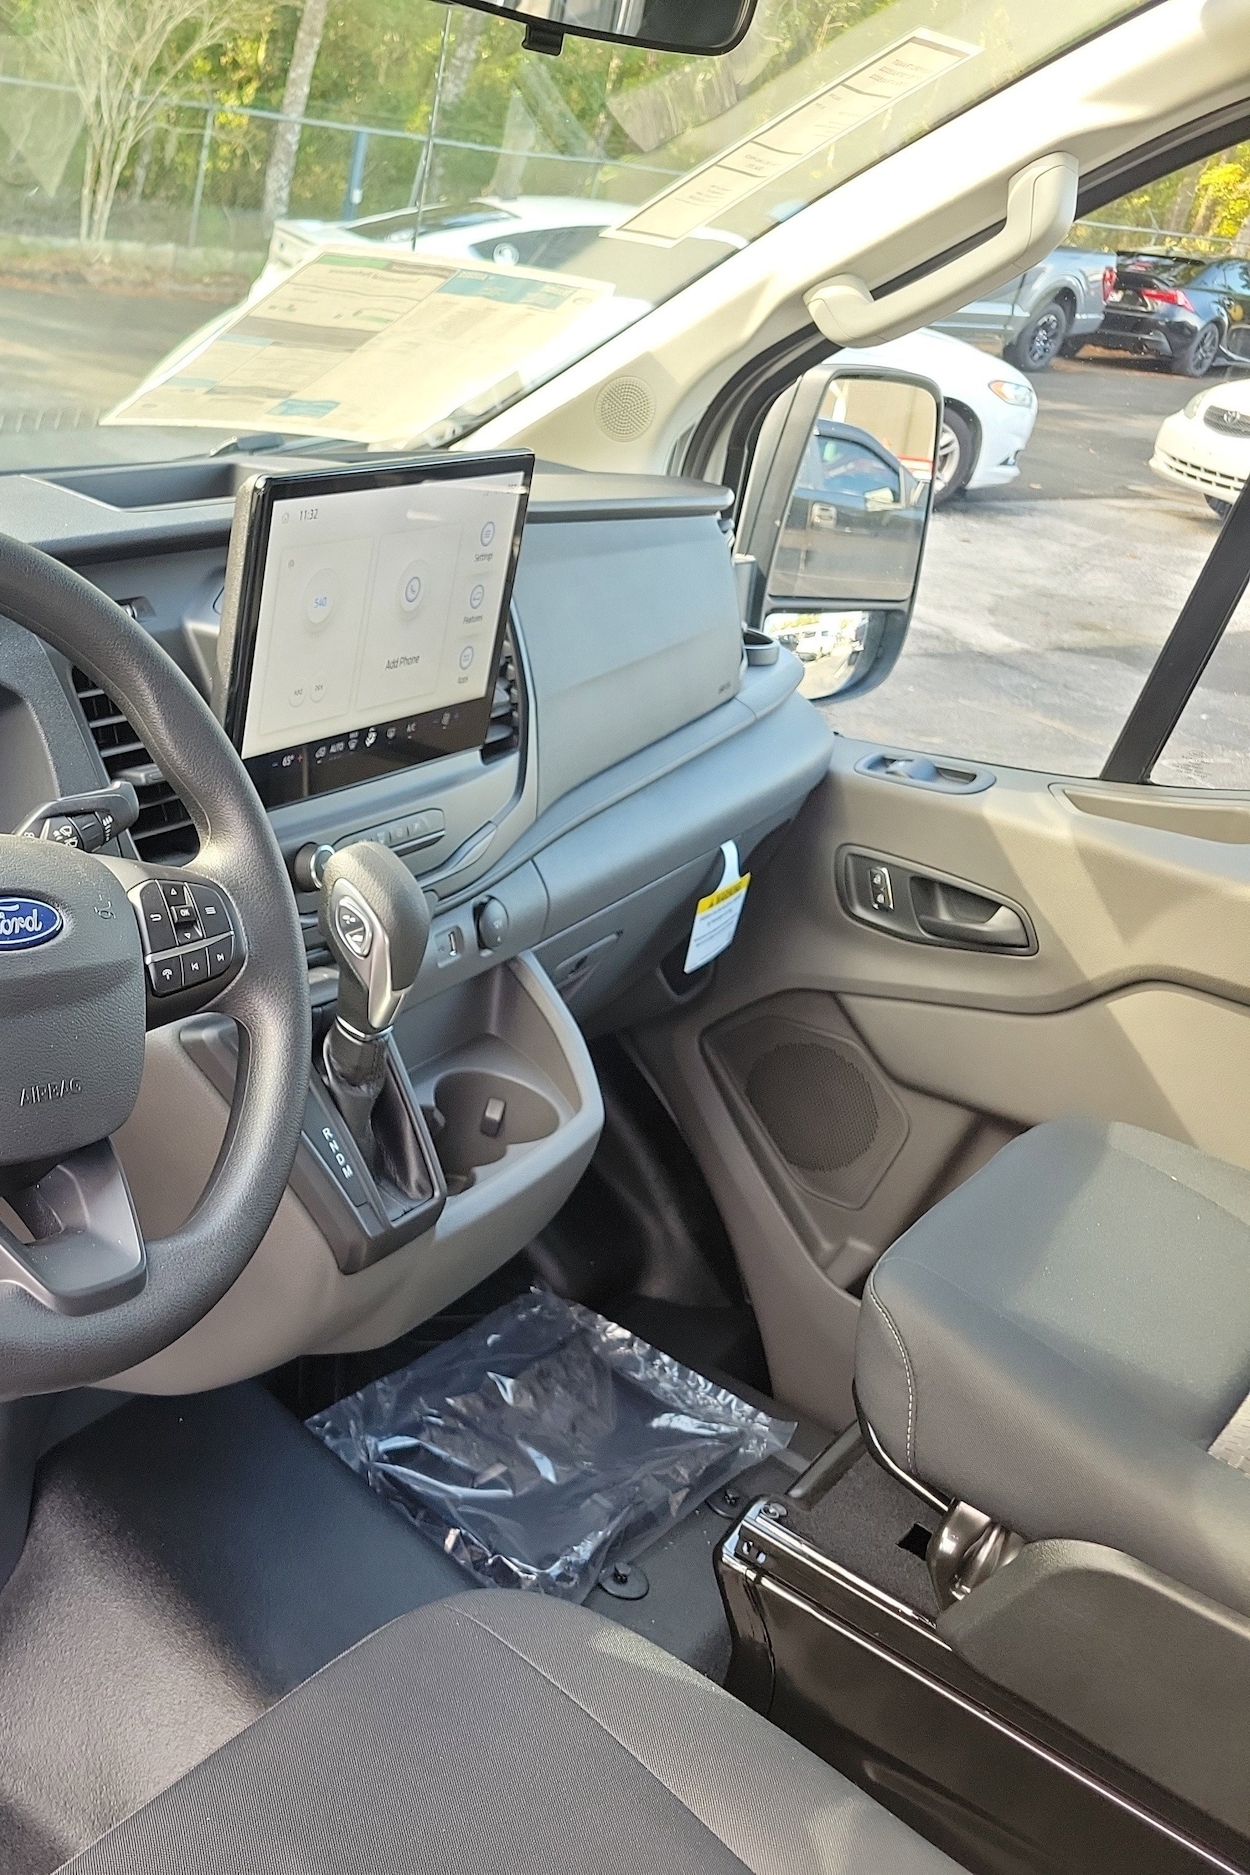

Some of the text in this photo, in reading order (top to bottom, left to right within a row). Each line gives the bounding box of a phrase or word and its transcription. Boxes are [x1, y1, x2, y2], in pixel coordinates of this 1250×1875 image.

[299, 508, 319, 521] 11:32
[385, 655, 420, 671] Add Phone
[329, 742, 345, 753] AUTO
[180, 908, 190, 917] OK
